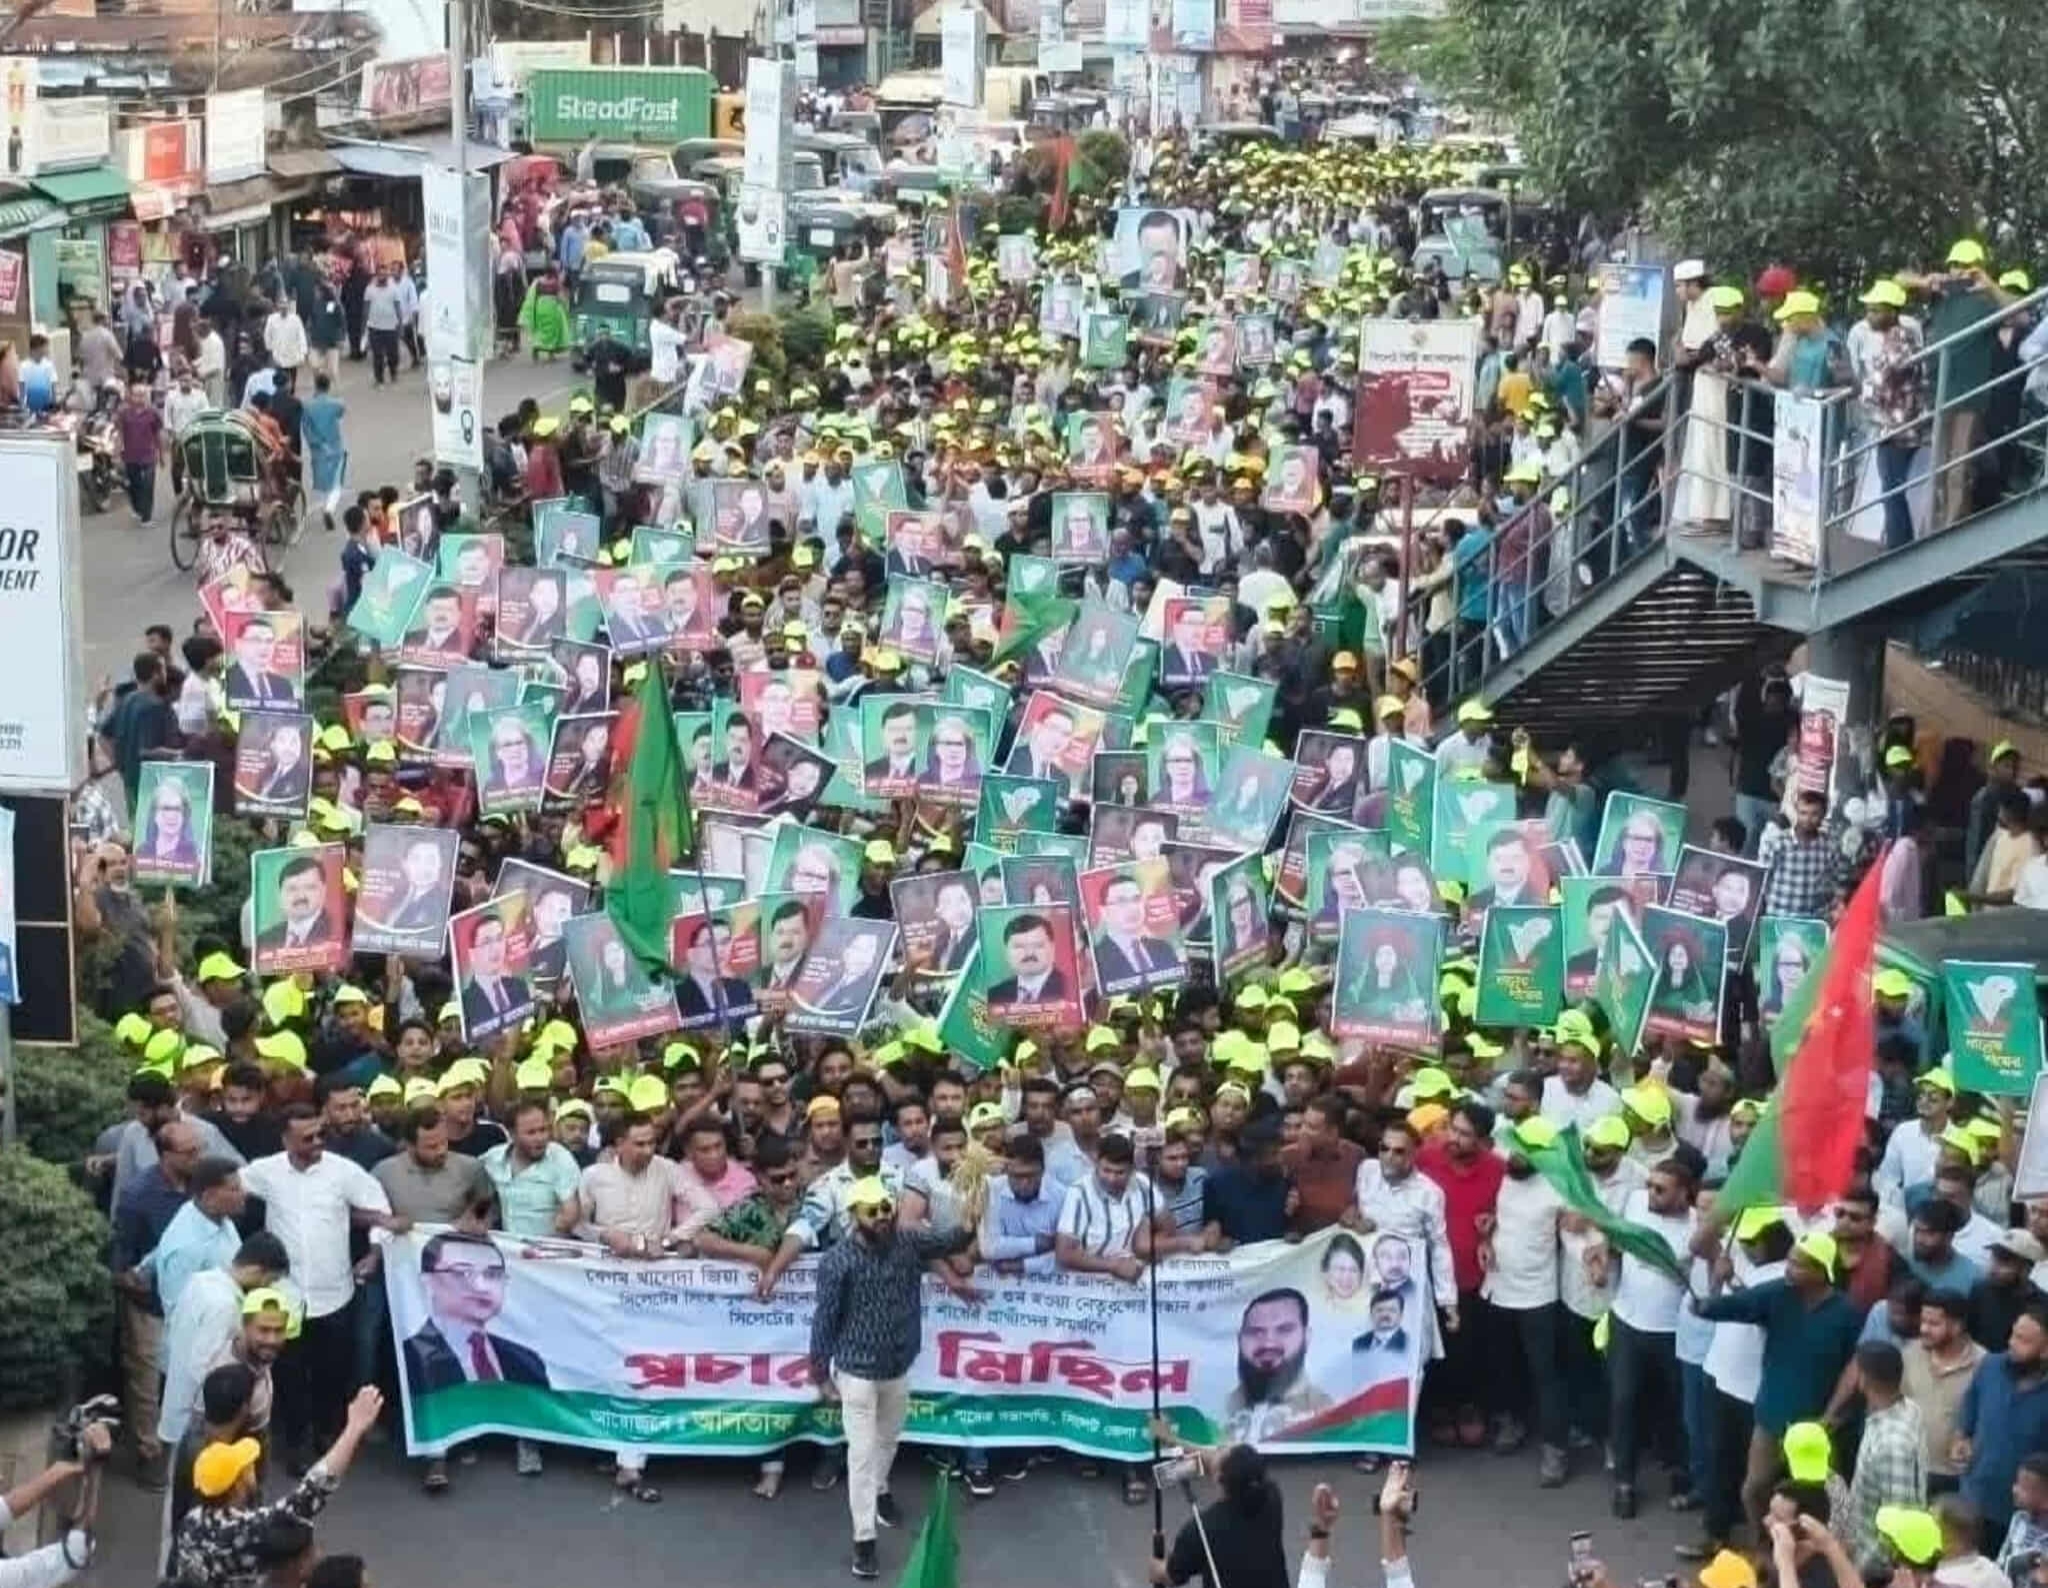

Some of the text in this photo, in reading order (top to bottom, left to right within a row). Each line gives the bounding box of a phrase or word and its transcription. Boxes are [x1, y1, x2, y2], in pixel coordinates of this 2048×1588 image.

[557, 95, 678, 121] SteadFast
[0, 569, 39, 590] ENT
[937, 1330, 1191, 1400] মিছিল
